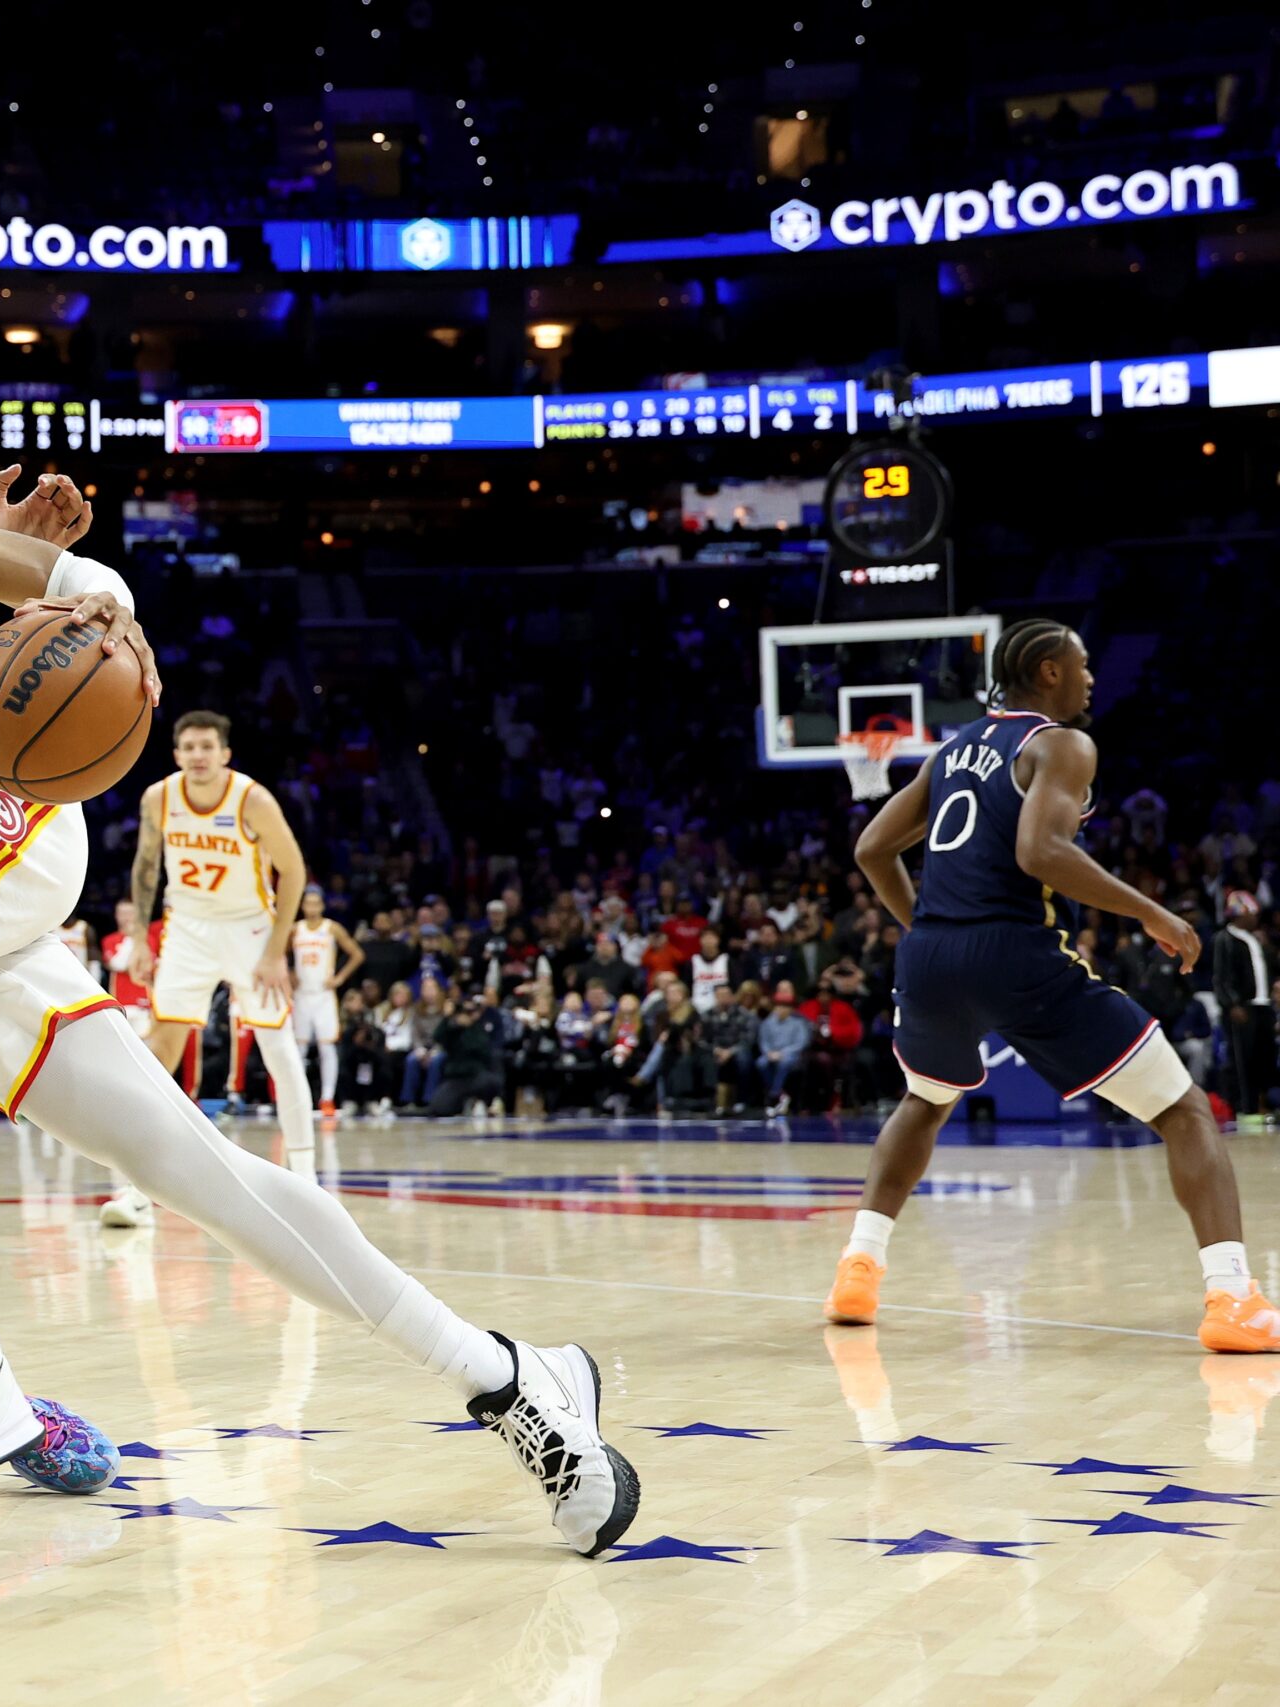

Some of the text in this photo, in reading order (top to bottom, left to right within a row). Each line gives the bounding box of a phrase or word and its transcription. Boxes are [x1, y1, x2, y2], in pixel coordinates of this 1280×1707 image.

[830, 161, 1240, 245] crypto.com
[1120, 361, 1190, 408] 126
[772, 408, 793, 431] 4
[2, 621, 104, 715] Wilson
[944, 743, 1004, 782] MAXEY
[929, 789, 978, 851] 0
[179, 859, 228, 892] 27
